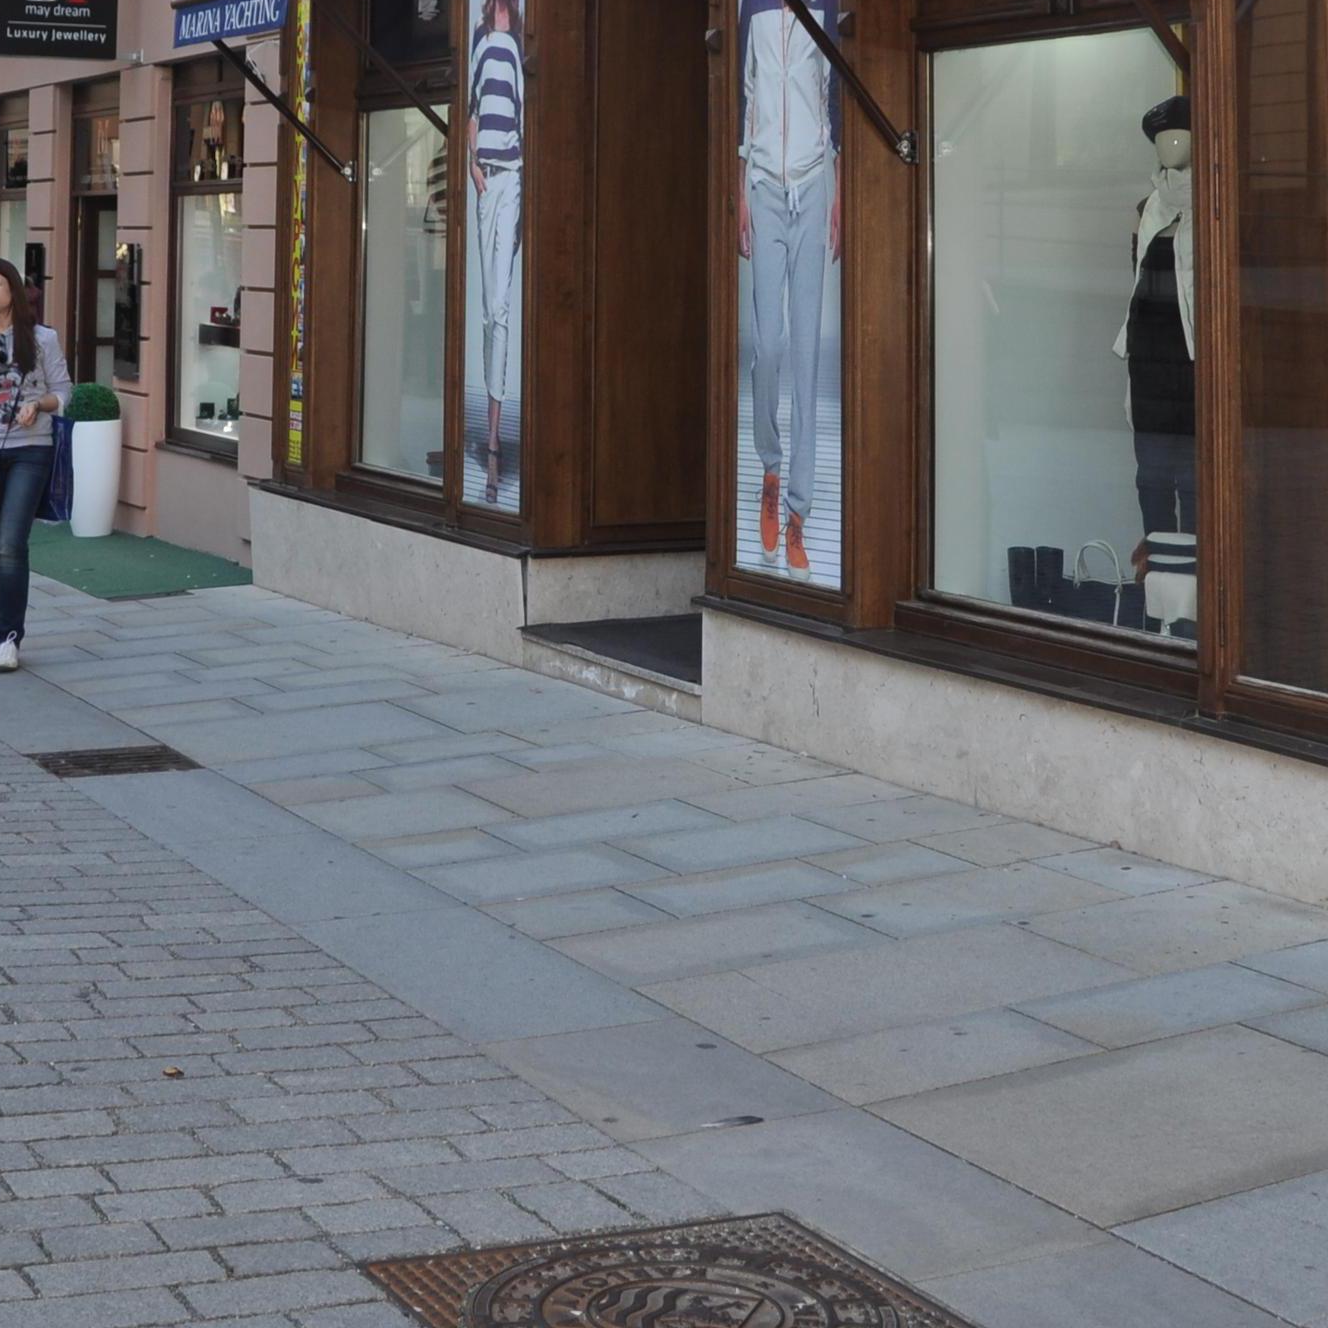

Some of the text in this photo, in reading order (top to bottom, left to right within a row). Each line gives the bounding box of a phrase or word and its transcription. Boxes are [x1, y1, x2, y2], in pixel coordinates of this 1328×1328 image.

[25, 4, 91, 18] may dream
[179, 6, 221, 40] MARINA
[6, 26, 48, 42] Luxury
